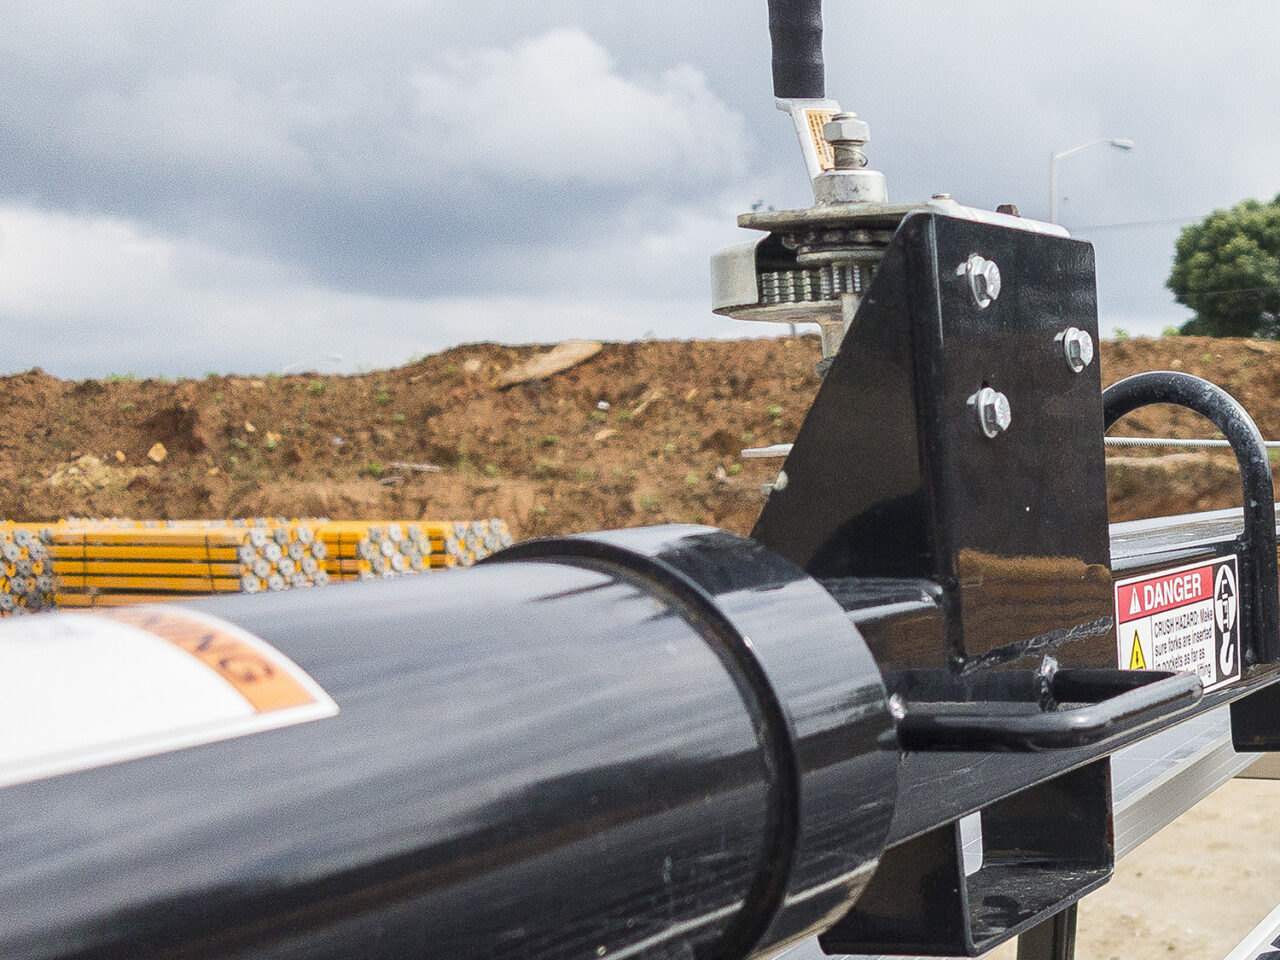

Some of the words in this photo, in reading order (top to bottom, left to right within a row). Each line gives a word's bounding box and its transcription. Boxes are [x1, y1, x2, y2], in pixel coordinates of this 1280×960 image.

[1144, 572, 1202, 612] DANGER
[1154, 617, 1174, 638] CRUSH
[1155, 643, 1168, 657] sure
[1168, 635, 1182, 652] forks
[1183, 634, 1191, 647] are
[1192, 624, 1213, 644] inserted
[1184, 652, 1190, 665] as
[1191, 648, 1199, 662] far
[1199, 647, 1205, 660] as
